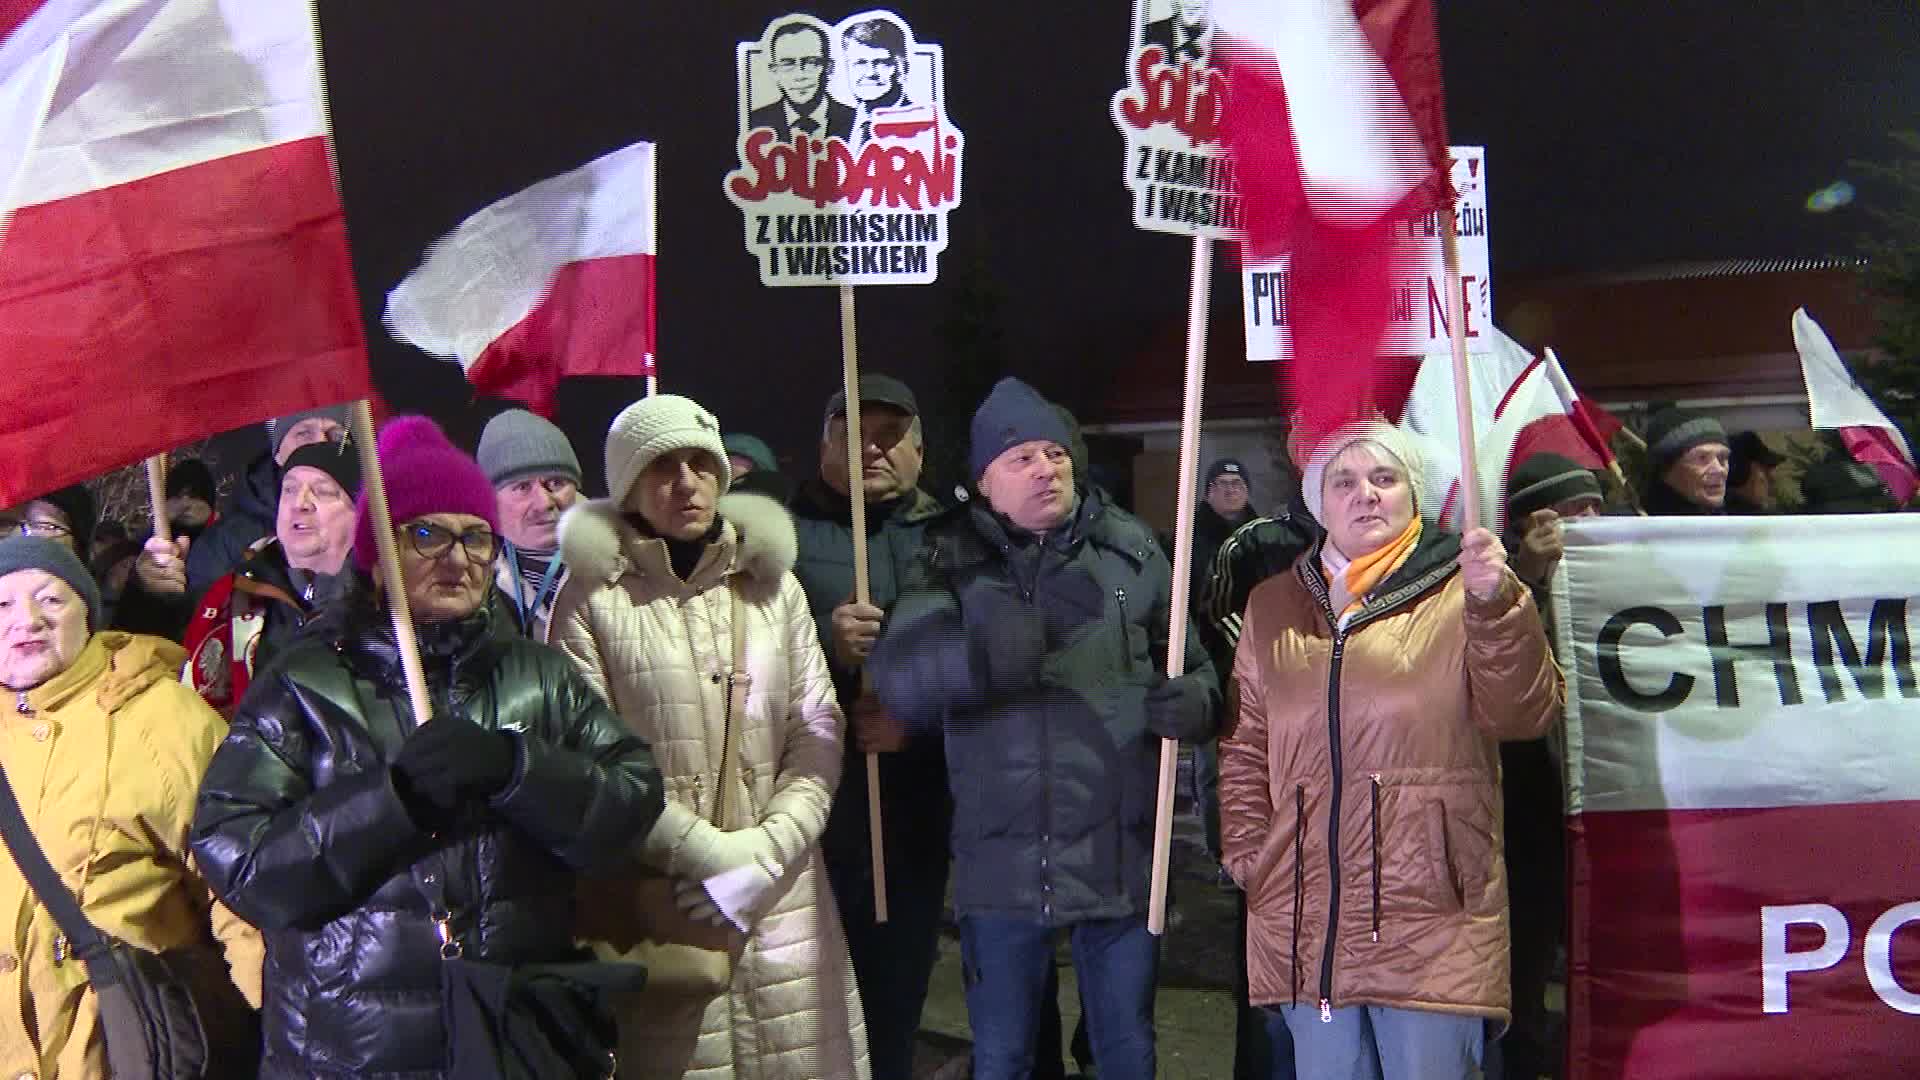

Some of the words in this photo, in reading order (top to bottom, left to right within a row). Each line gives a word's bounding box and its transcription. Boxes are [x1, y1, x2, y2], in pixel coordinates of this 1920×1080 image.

[1136, 146, 1152, 180] Z
[1145, 184, 1155, 218] I
[756, 214, 770, 244] Z
[777, 210, 938, 244] KAMIŃSKIM
[770, 248, 779, 276] I
[785, 245, 928, 280] WĄSIKIEM
